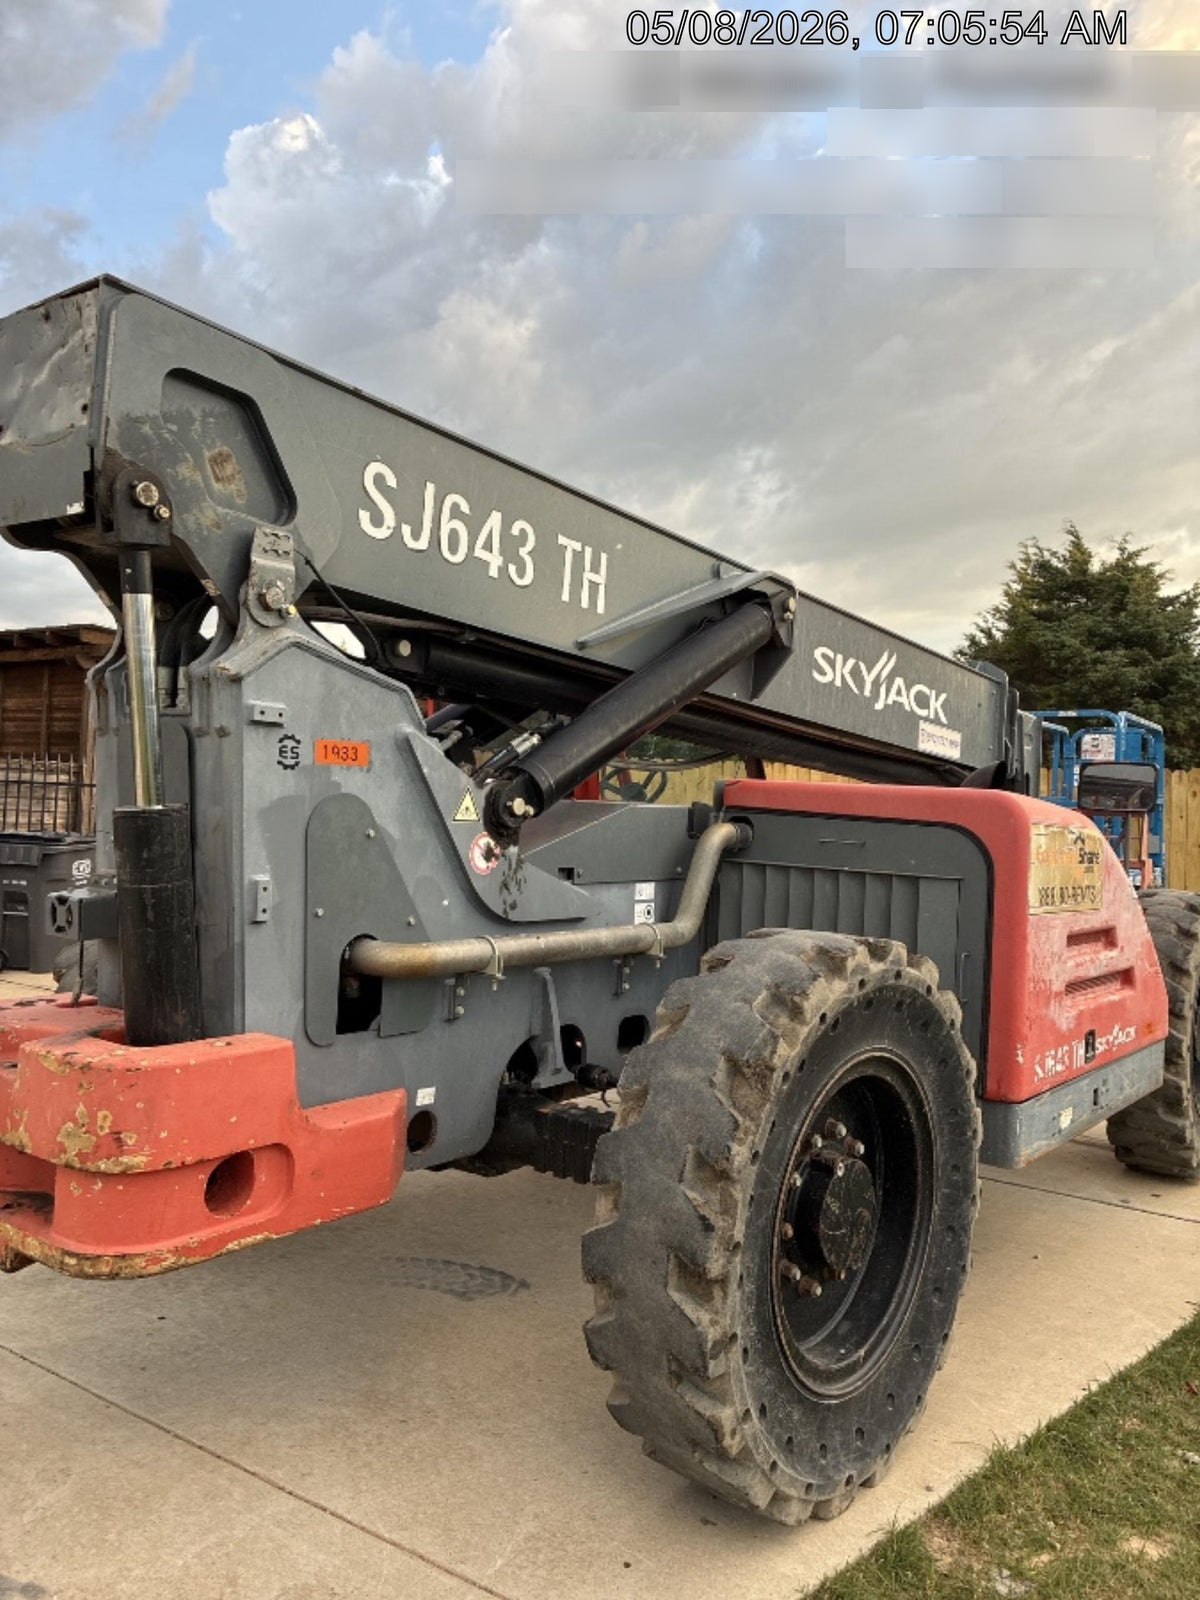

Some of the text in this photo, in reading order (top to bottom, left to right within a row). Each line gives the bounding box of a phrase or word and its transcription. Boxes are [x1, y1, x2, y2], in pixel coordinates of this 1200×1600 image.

[358, 461, 608, 614] SJ643 TH
[811, 645, 949, 725] SKYJACK
[278, 745, 300, 760] ES
[323, 745, 358, 762] 1933
